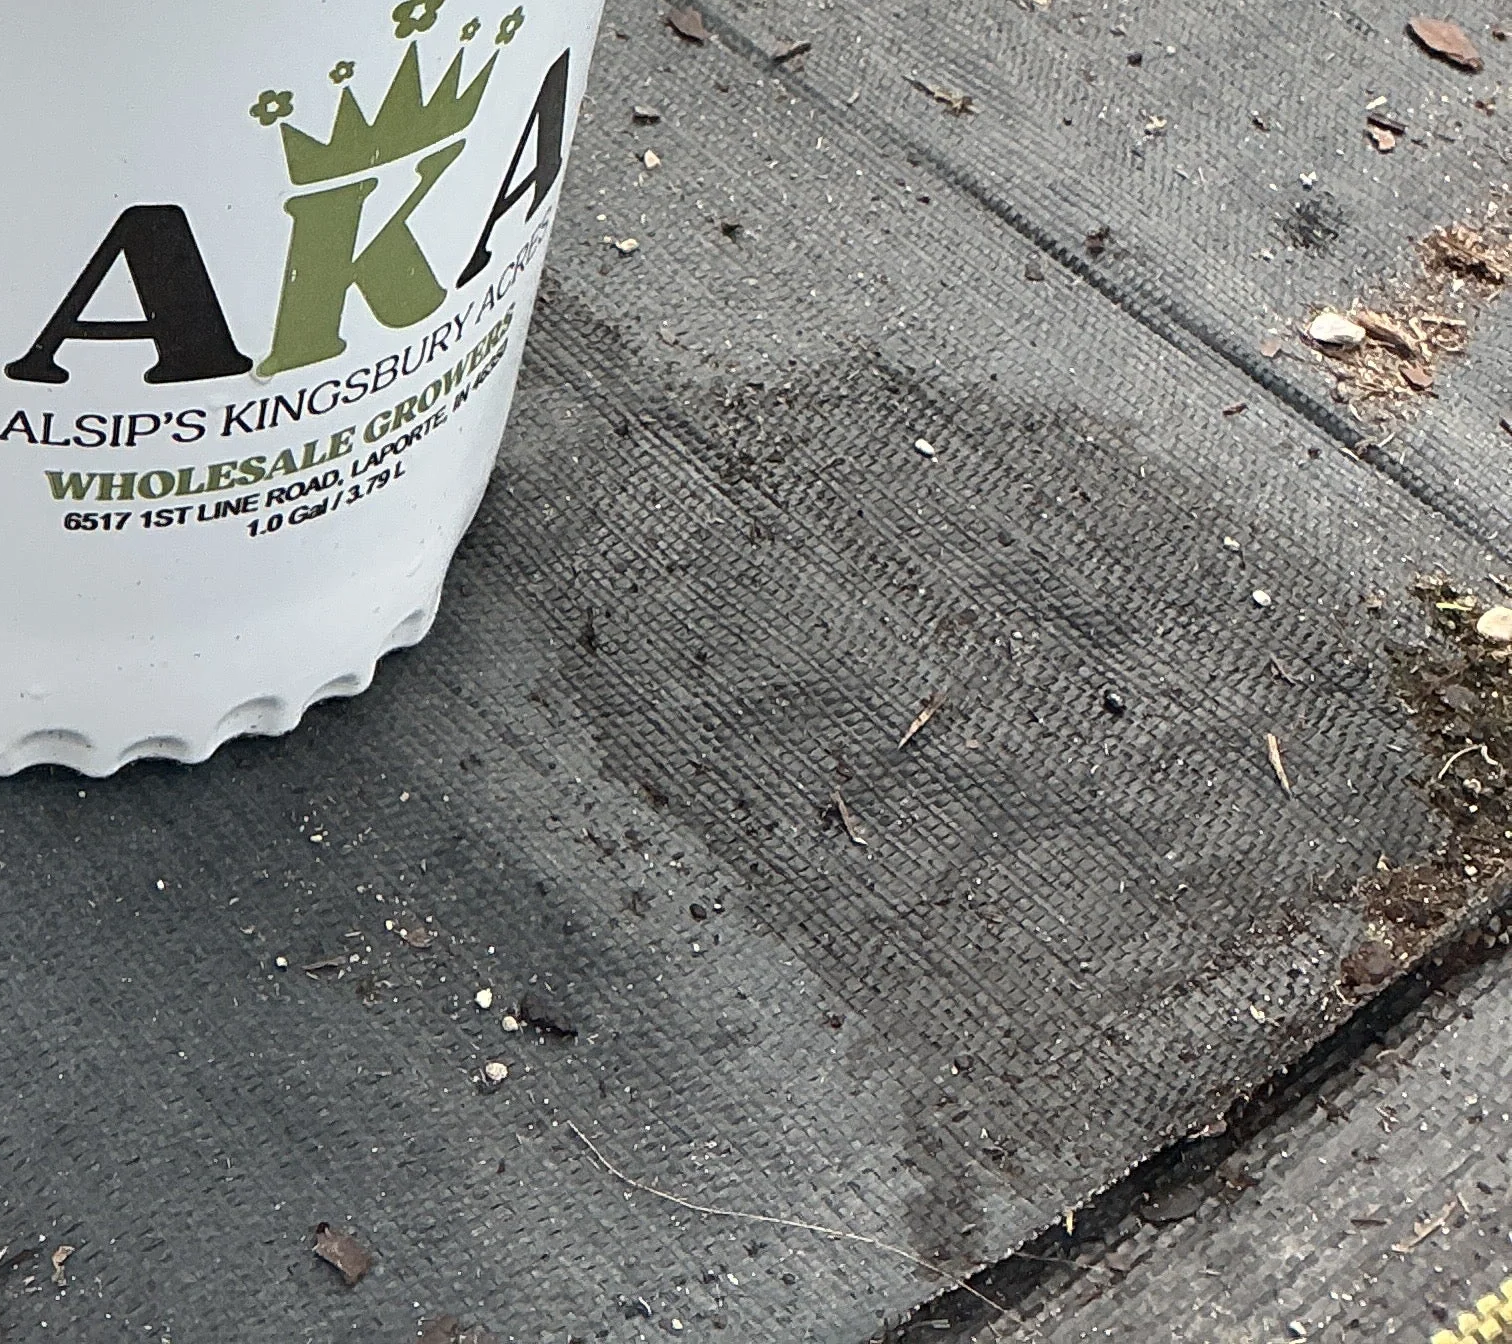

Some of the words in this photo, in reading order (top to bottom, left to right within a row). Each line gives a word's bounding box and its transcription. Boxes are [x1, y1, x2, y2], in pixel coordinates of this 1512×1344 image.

[5, 47, 569, 384] AKA
[45, 425, 357, 502] WHOLESALE
[363, 302, 516, 444] GROWERS
[219, 300, 475, 437] KINGSBURY
[475, 205, 553, 325] ACRES
[64, 512, 132, 531] 6517
[139, 506, 194, 530] 1ST
[197, 493, 261, 523] LINE
[452, 382, 470, 413] IN
[247, 513, 284, 538] 1.0
[288, 496, 329, 525] Gal
[345, 468, 391, 505] 3.79
[393, 460, 406, 480] L
